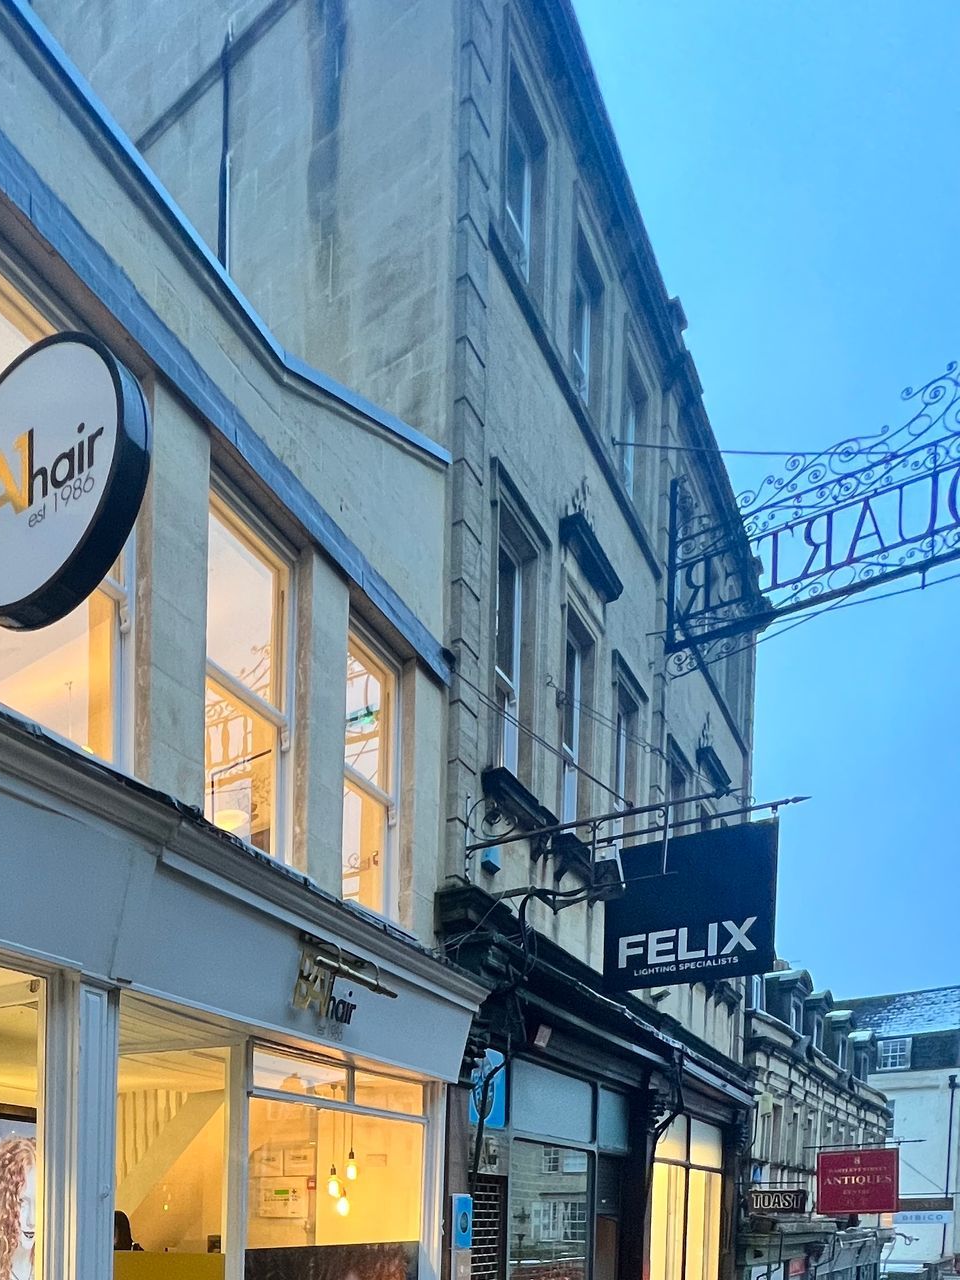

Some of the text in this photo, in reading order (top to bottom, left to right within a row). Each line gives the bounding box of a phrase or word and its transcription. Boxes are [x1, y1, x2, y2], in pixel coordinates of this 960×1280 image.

[27, 475, 95, 528] est 1986
[617, 916, 758, 969] FELIX
[633, 956, 739, 977] LIGHTING SPECIALISTS
[824, 1174, 892, 1186] ANTIQUES
[752, 1192, 803, 1209] TOAST
